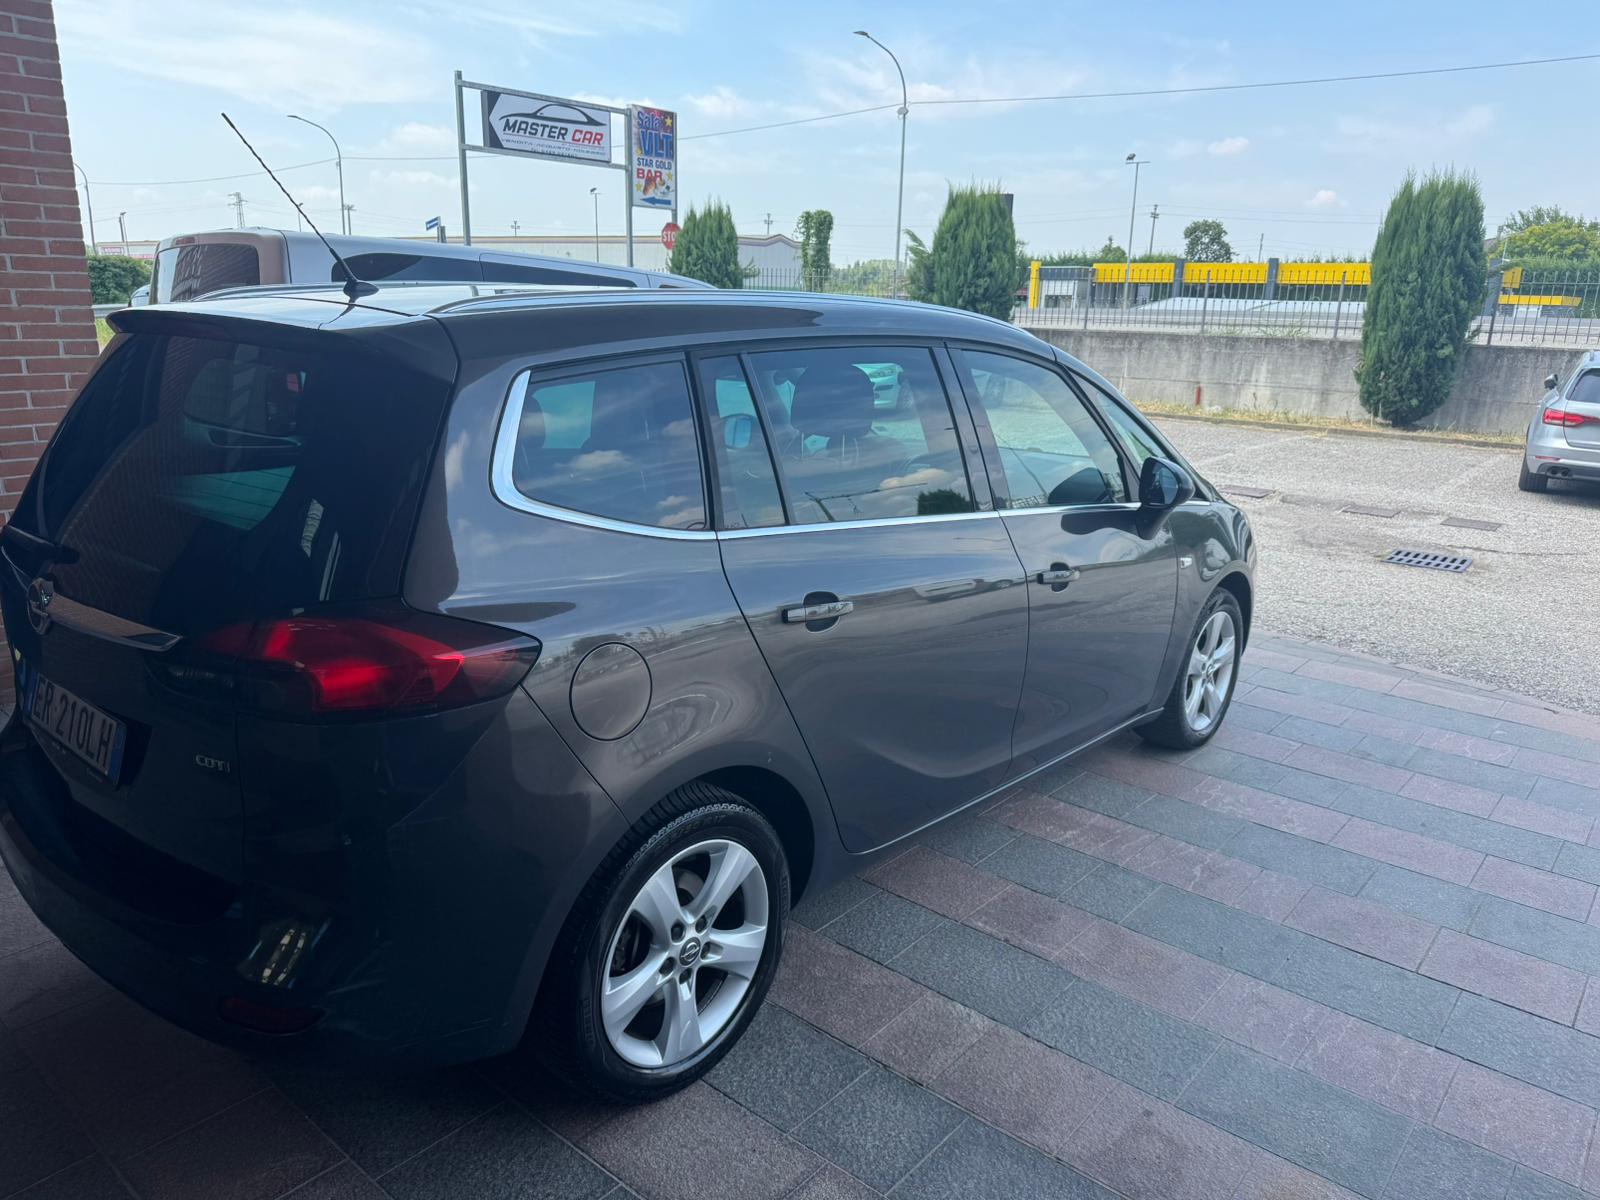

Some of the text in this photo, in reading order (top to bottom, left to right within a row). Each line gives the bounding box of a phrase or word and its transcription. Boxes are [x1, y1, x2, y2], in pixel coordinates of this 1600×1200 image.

[503, 118, 604, 146] MASTER CAR
[637, 157, 672, 170] STAR GOLD
[637, 168, 663, 180] BAR
[662, 231, 676, 242] STO
